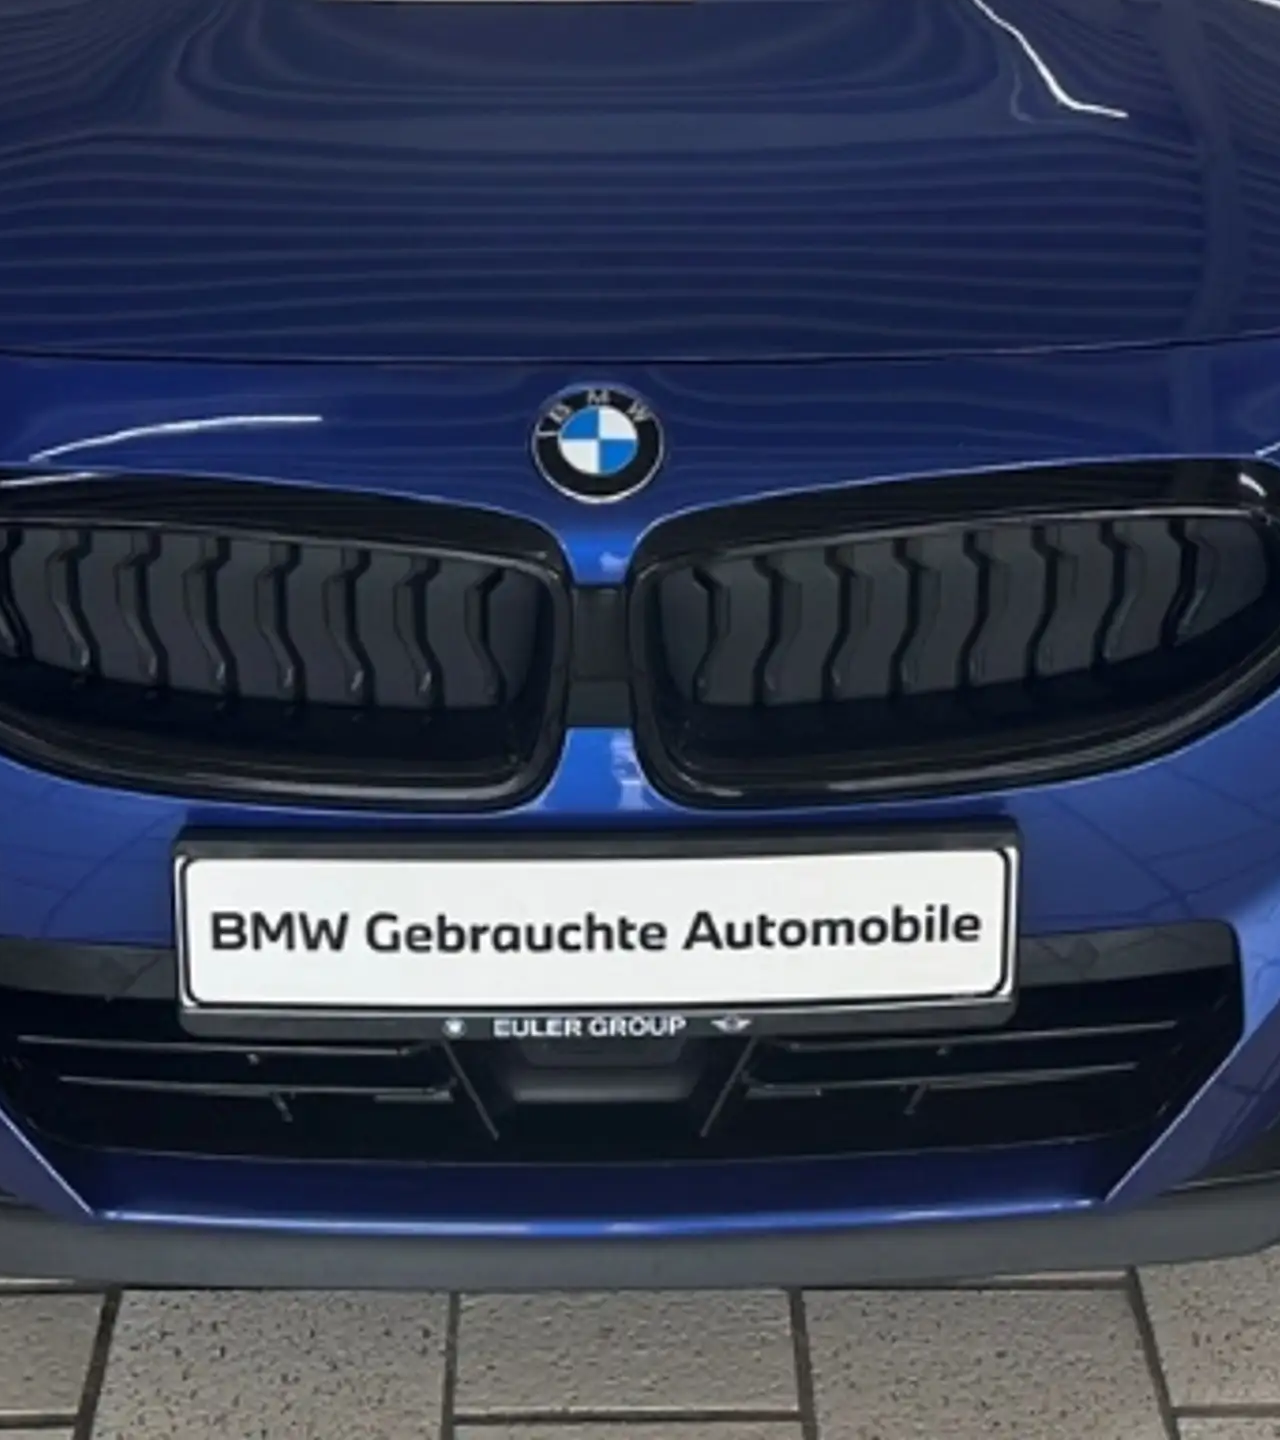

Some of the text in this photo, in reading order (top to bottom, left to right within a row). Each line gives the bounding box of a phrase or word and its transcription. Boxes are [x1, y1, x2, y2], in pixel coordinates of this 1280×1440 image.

[210, 903, 982, 953] BMW Gebrauchte Automobile
[493, 1014, 687, 1037] EULER GROUP
